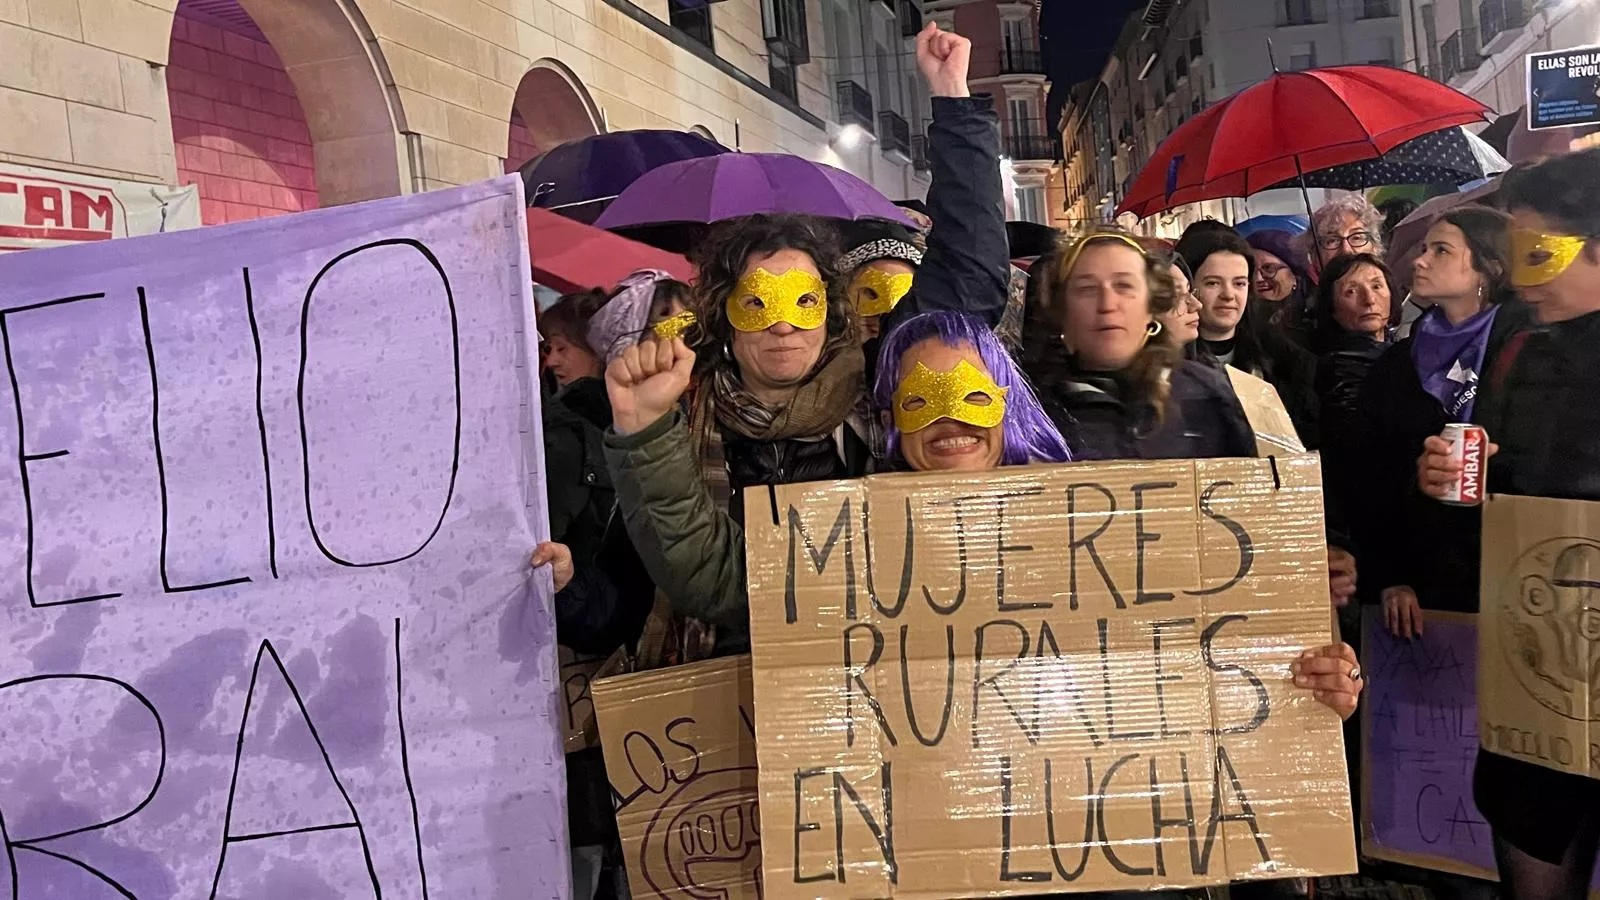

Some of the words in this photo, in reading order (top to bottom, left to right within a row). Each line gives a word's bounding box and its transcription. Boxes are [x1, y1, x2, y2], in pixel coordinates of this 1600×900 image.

[1538, 57, 1566, 70] ELLAS
[1568, 54, 1589, 67] SON
[1568, 65, 1600, 78] REVOL
[1463, 440, 1480, 499] AMBAR
[785, 481, 1254, 624] MUJERES
[844, 614, 1271, 748] RURALES
[793, 759, 899, 885] EN
[999, 745, 1275, 882] LUCHA
